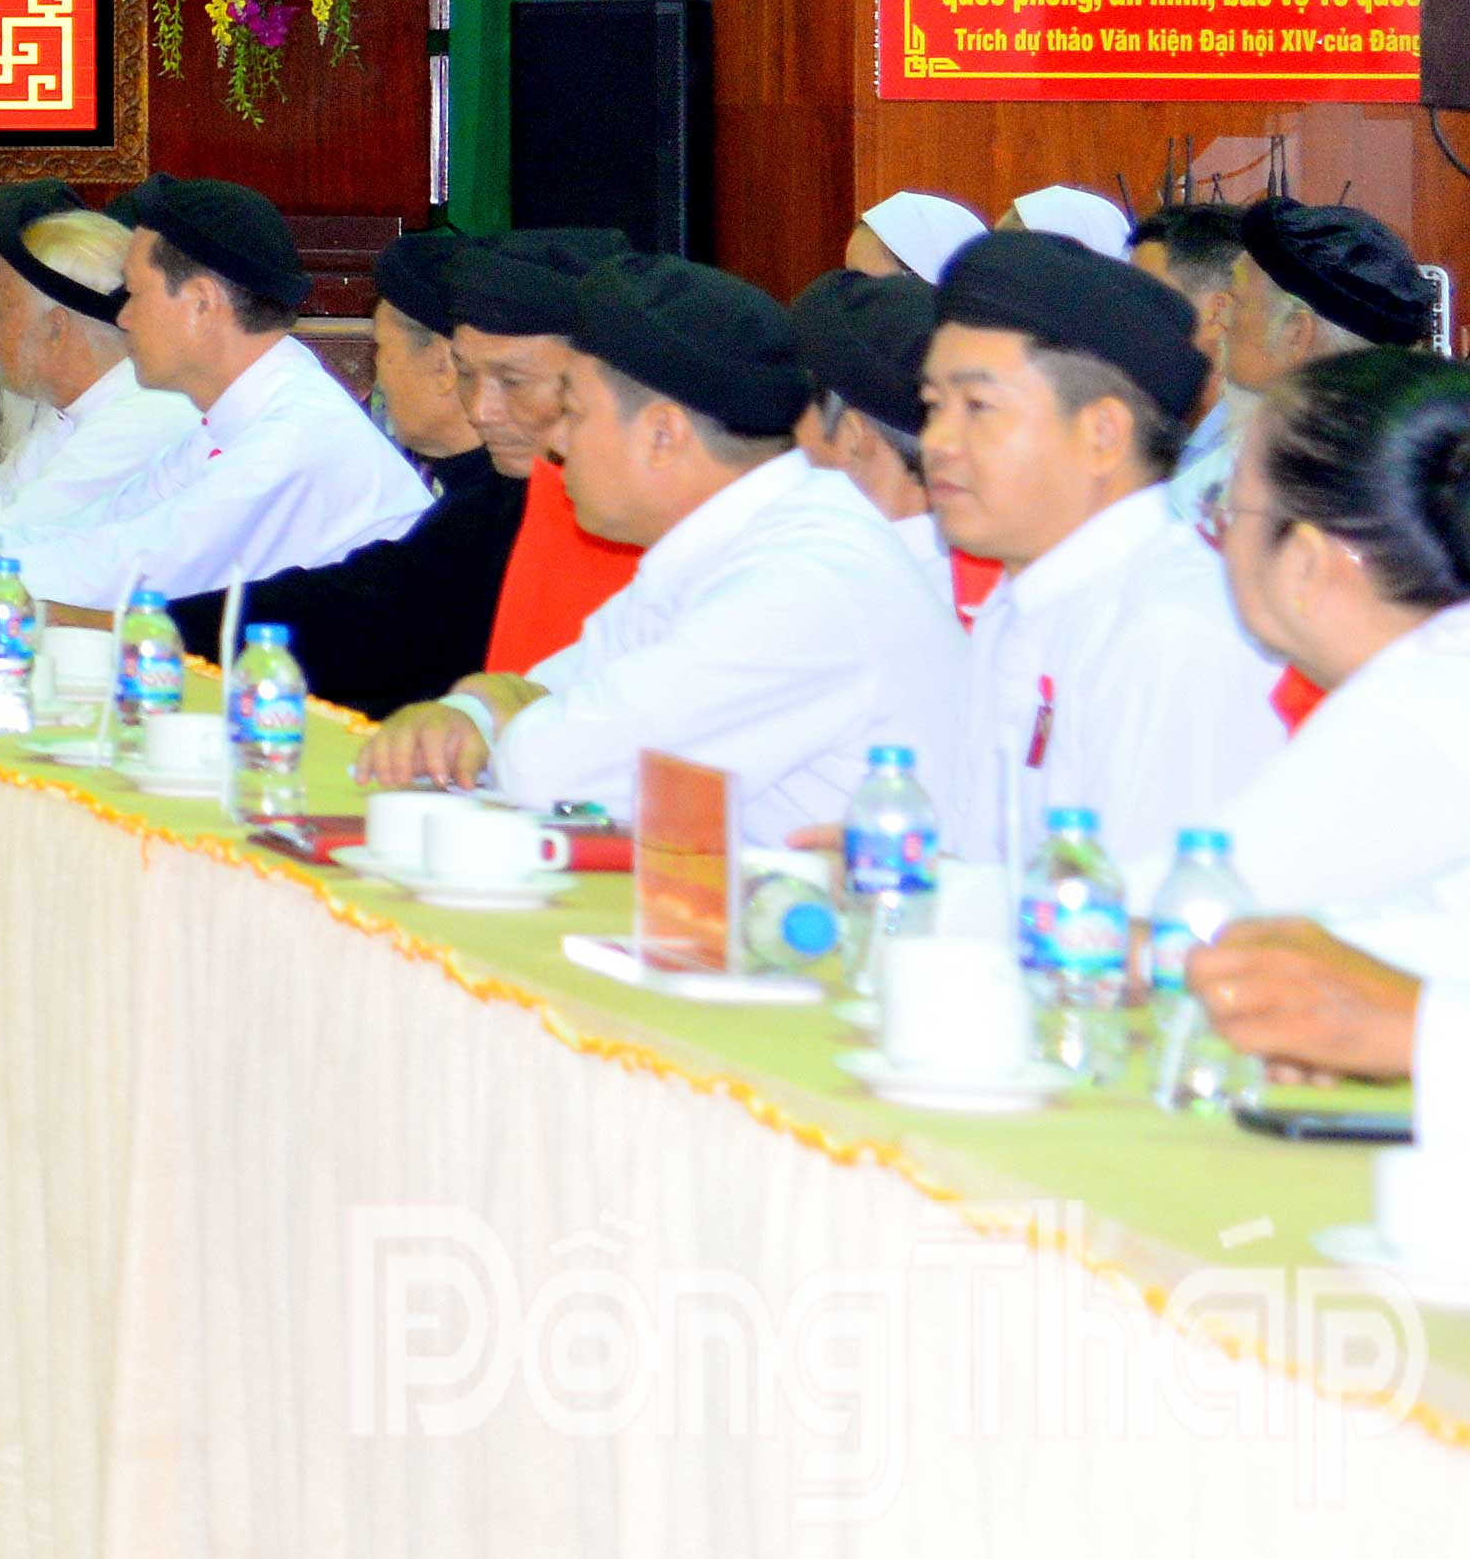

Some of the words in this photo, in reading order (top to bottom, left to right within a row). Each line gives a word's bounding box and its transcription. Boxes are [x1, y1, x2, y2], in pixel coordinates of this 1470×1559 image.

[955, 29, 1007, 51] Trích
[1015, 29, 1041, 56] dự
[1047, 27, 1093, 51] thảo
[1101, 29, 1140, 51] Văn
[1149, 29, 1192, 56] kiện
[1200, 30, 1234, 56] Đại
[1243, 30, 1273, 56] hội
[1282, 30, 1316, 51] XIV
[1324, 28, 1362, 51] của
